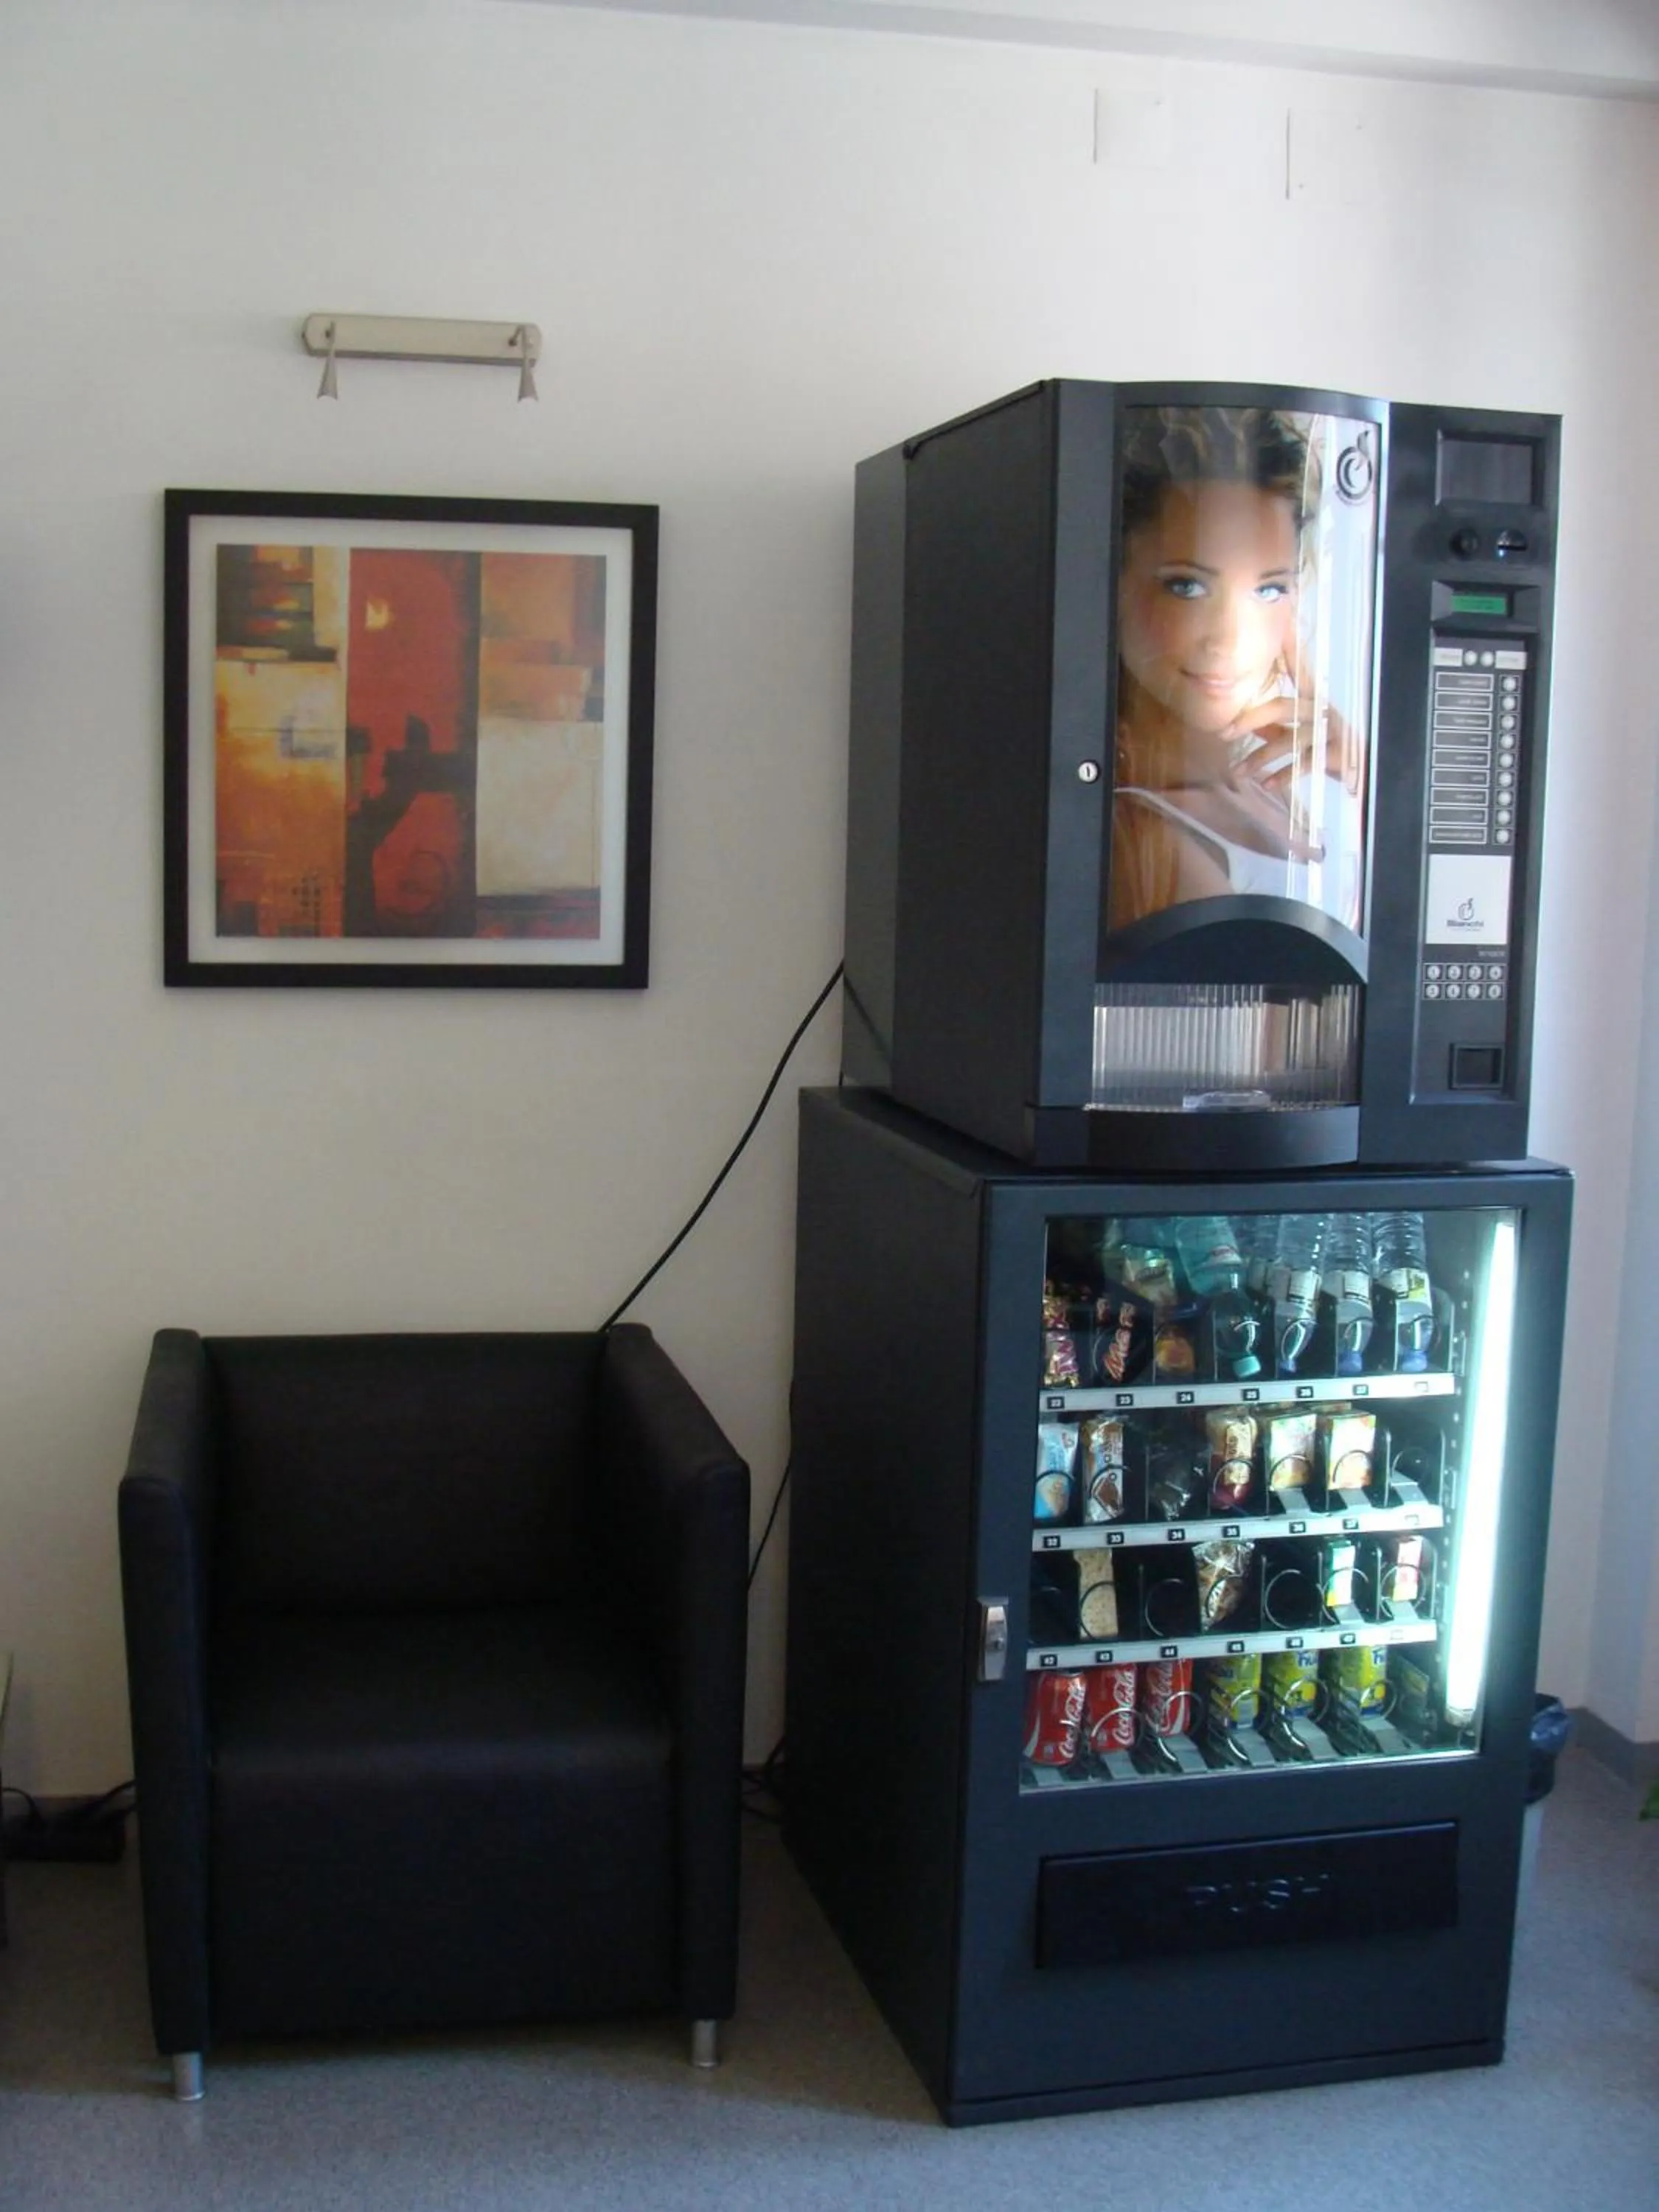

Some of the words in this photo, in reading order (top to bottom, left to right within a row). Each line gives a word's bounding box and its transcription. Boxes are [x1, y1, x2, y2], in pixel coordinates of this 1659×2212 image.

[1119, 1396, 1131, 1405] 23
[1180, 1393, 1192, 1402] 24
[1172, 1530, 1182, 1540] 34
[1226, 1526, 1237, 1536] 35
[1046, 1537, 1057, 1546] 32
[1110, 1533, 1121, 1543] 33
[1164, 1646, 1175, 1656] 44
[1044, 1656, 1054, 1665] 42
[1112, 1668, 1136, 1747] CocaCola
[1058, 1677, 1086, 1759] CocaCola
